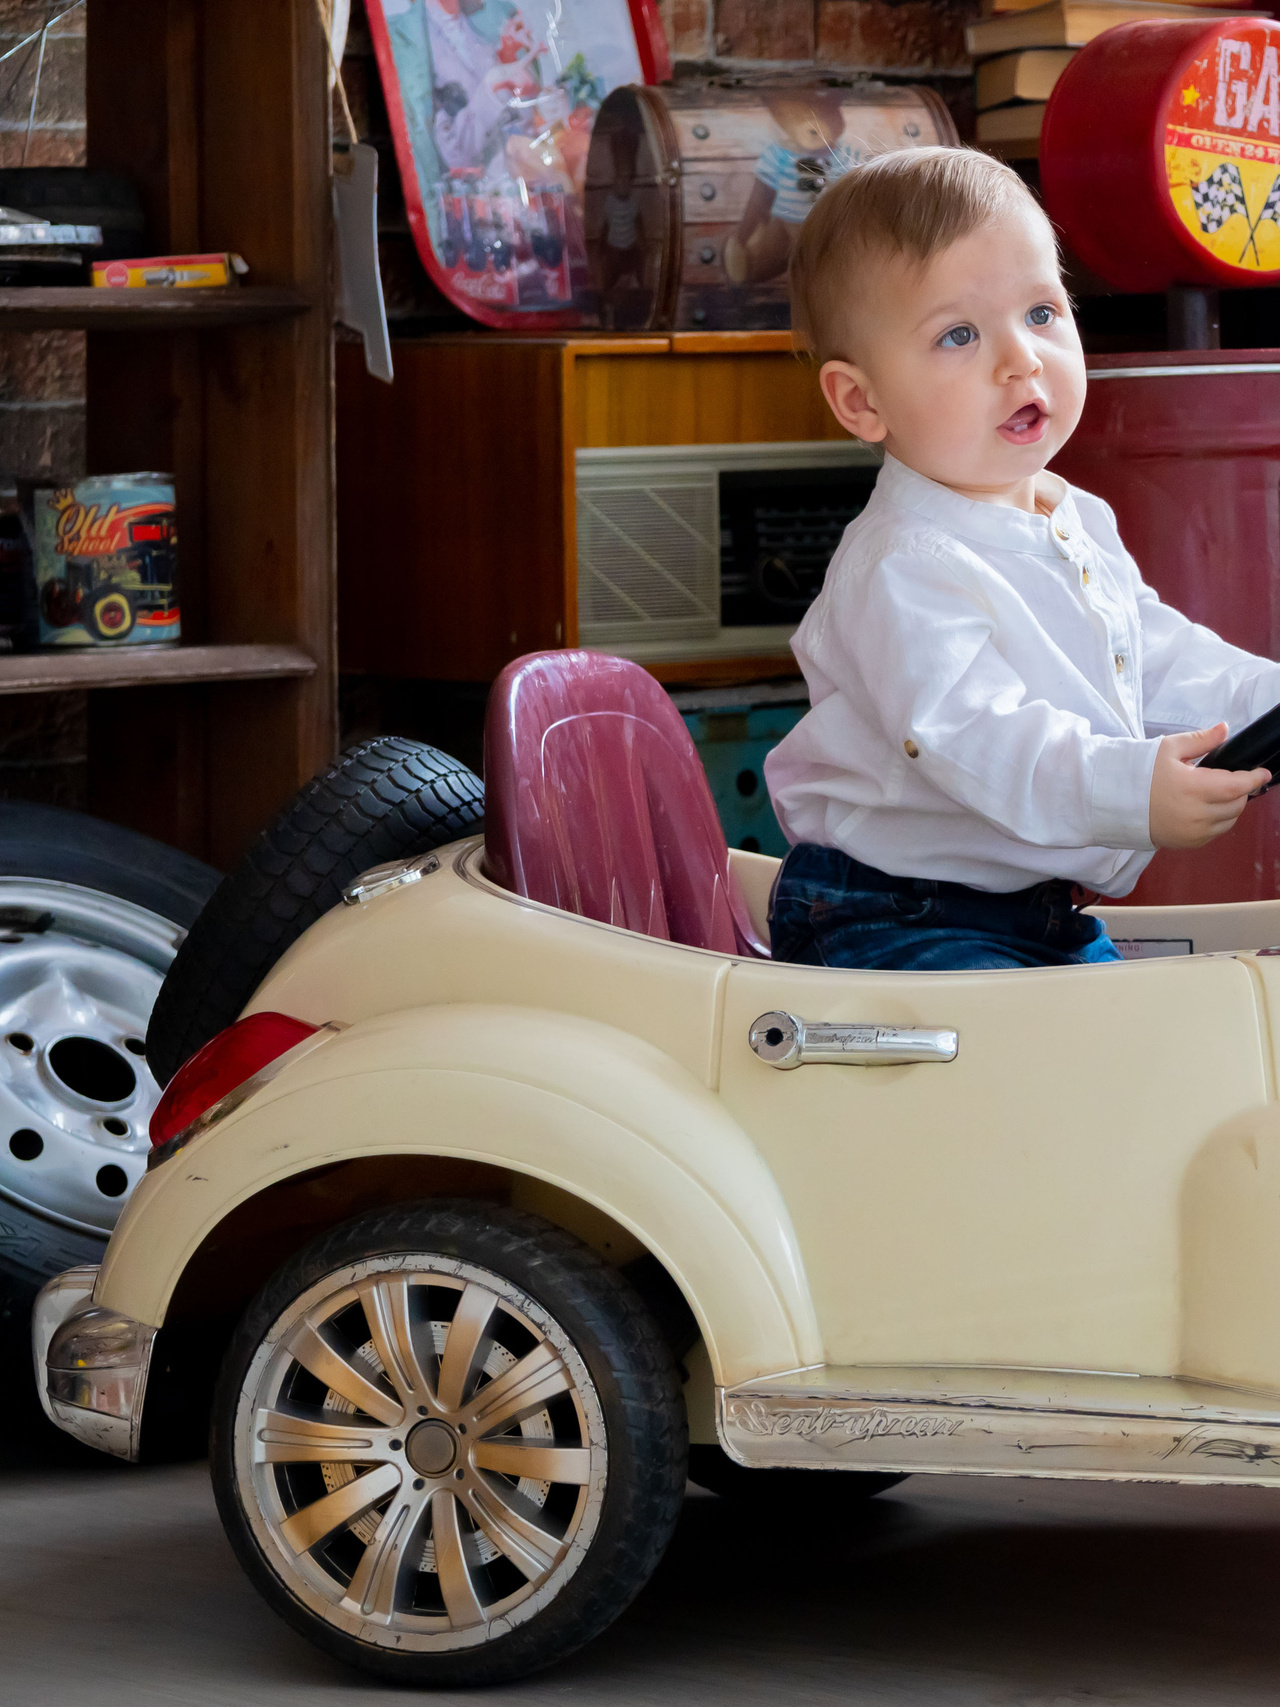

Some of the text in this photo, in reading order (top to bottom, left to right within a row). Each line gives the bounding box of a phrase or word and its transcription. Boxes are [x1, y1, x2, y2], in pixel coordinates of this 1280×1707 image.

[1243, 143, 1265, 159] 24
[57, 502, 120, 539] Old
[55, 529, 121, 556] School
